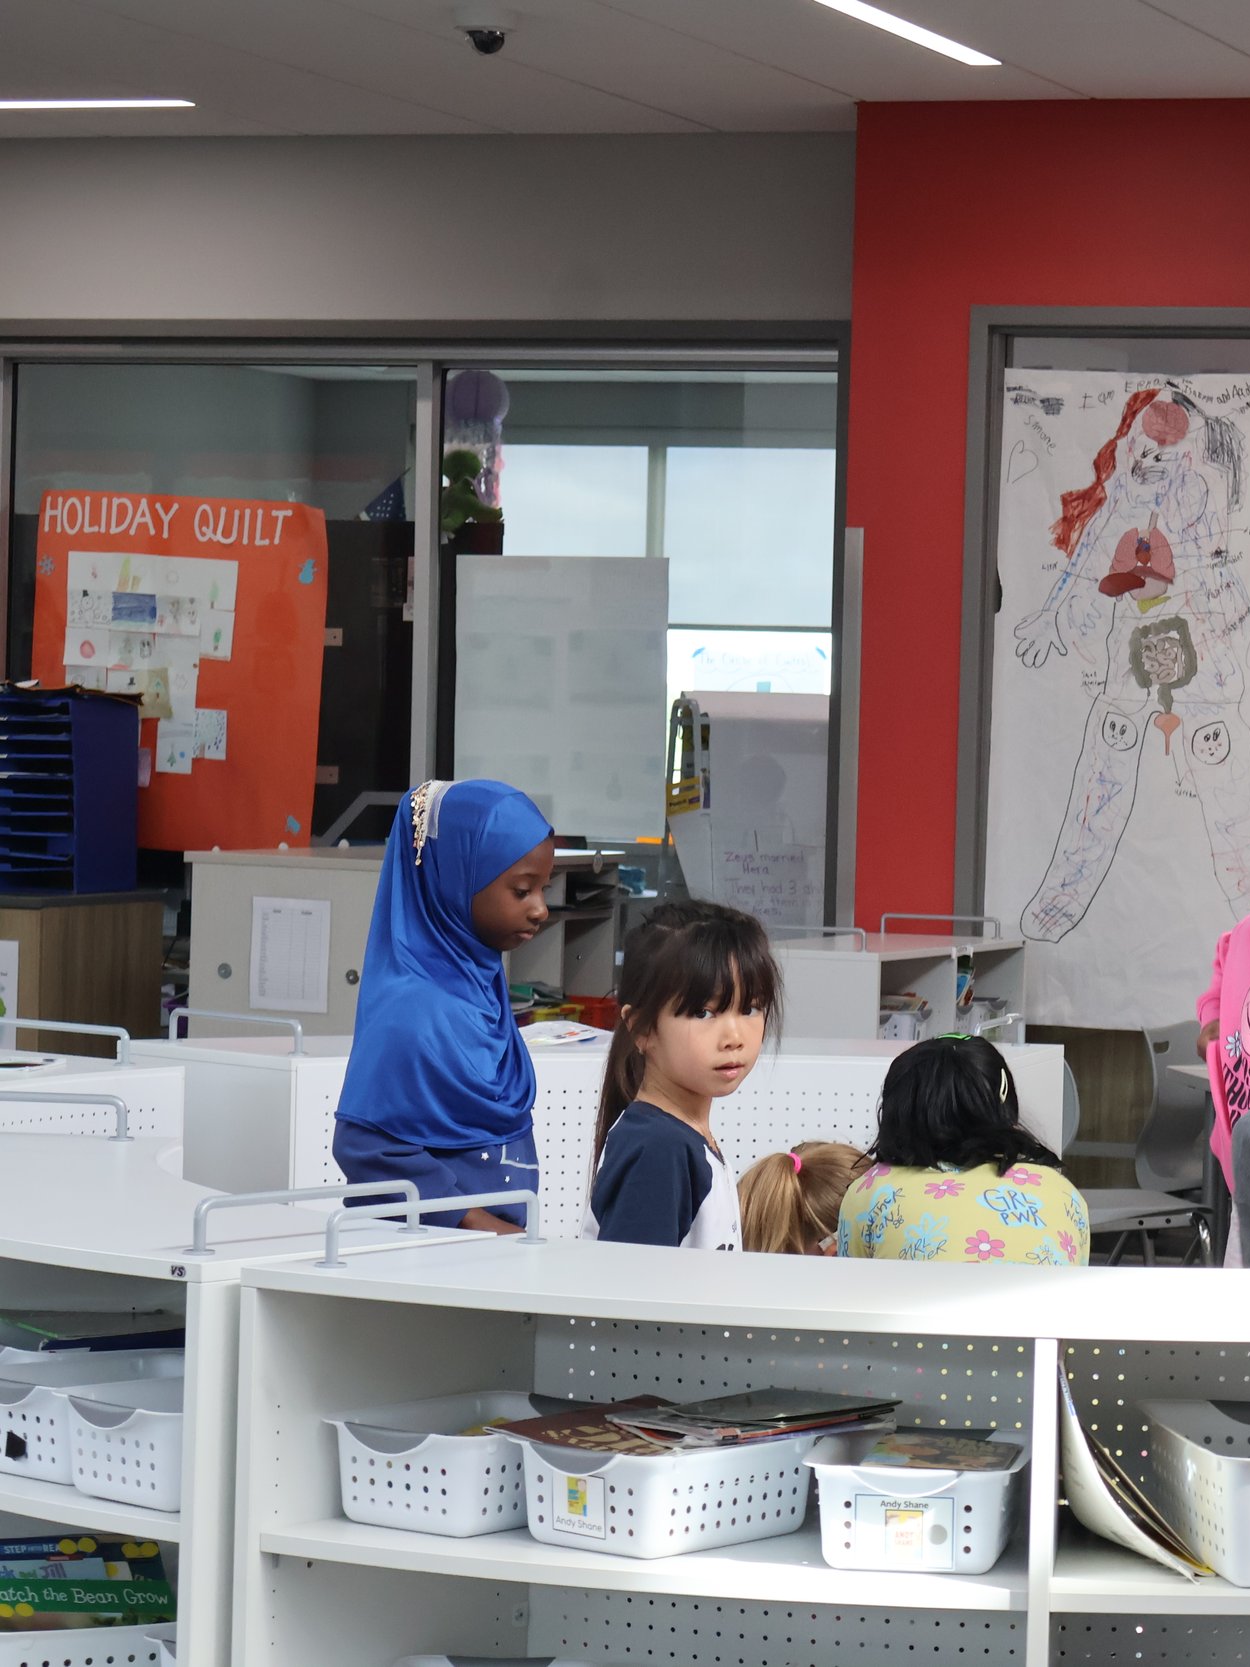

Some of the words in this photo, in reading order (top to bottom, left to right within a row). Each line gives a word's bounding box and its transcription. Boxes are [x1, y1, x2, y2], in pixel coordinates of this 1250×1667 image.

[1023, 414, 1057, 456] Simone
[44, 496, 179, 538] HOLIDAY
[194, 504, 292, 546] QUILT
[724, 851, 755, 863] Zeus
[742, 863, 769, 875] Hera
[788, 880, 798, 895] 3
[983, 1188, 1037, 1212] GRL
[1000, 1205, 1047, 1226] PWR
[171, 1265, 186, 1277] VS
[880, 1500, 901, 1509] Andy
[903, 1500, 929, 1509] Shane
[556, 1515, 576, 1528] Andy
[577, 1519, 602, 1532] Shane
[4, 1544, 27, 1554] STEP
[40, 1562, 67, 1579] Jill
[0, 1586, 39, 1602] atch
[43, 1587, 67, 1602] the
[70, 1588, 118, 1604] Bean
[123, 1588, 168, 1605] Grow
